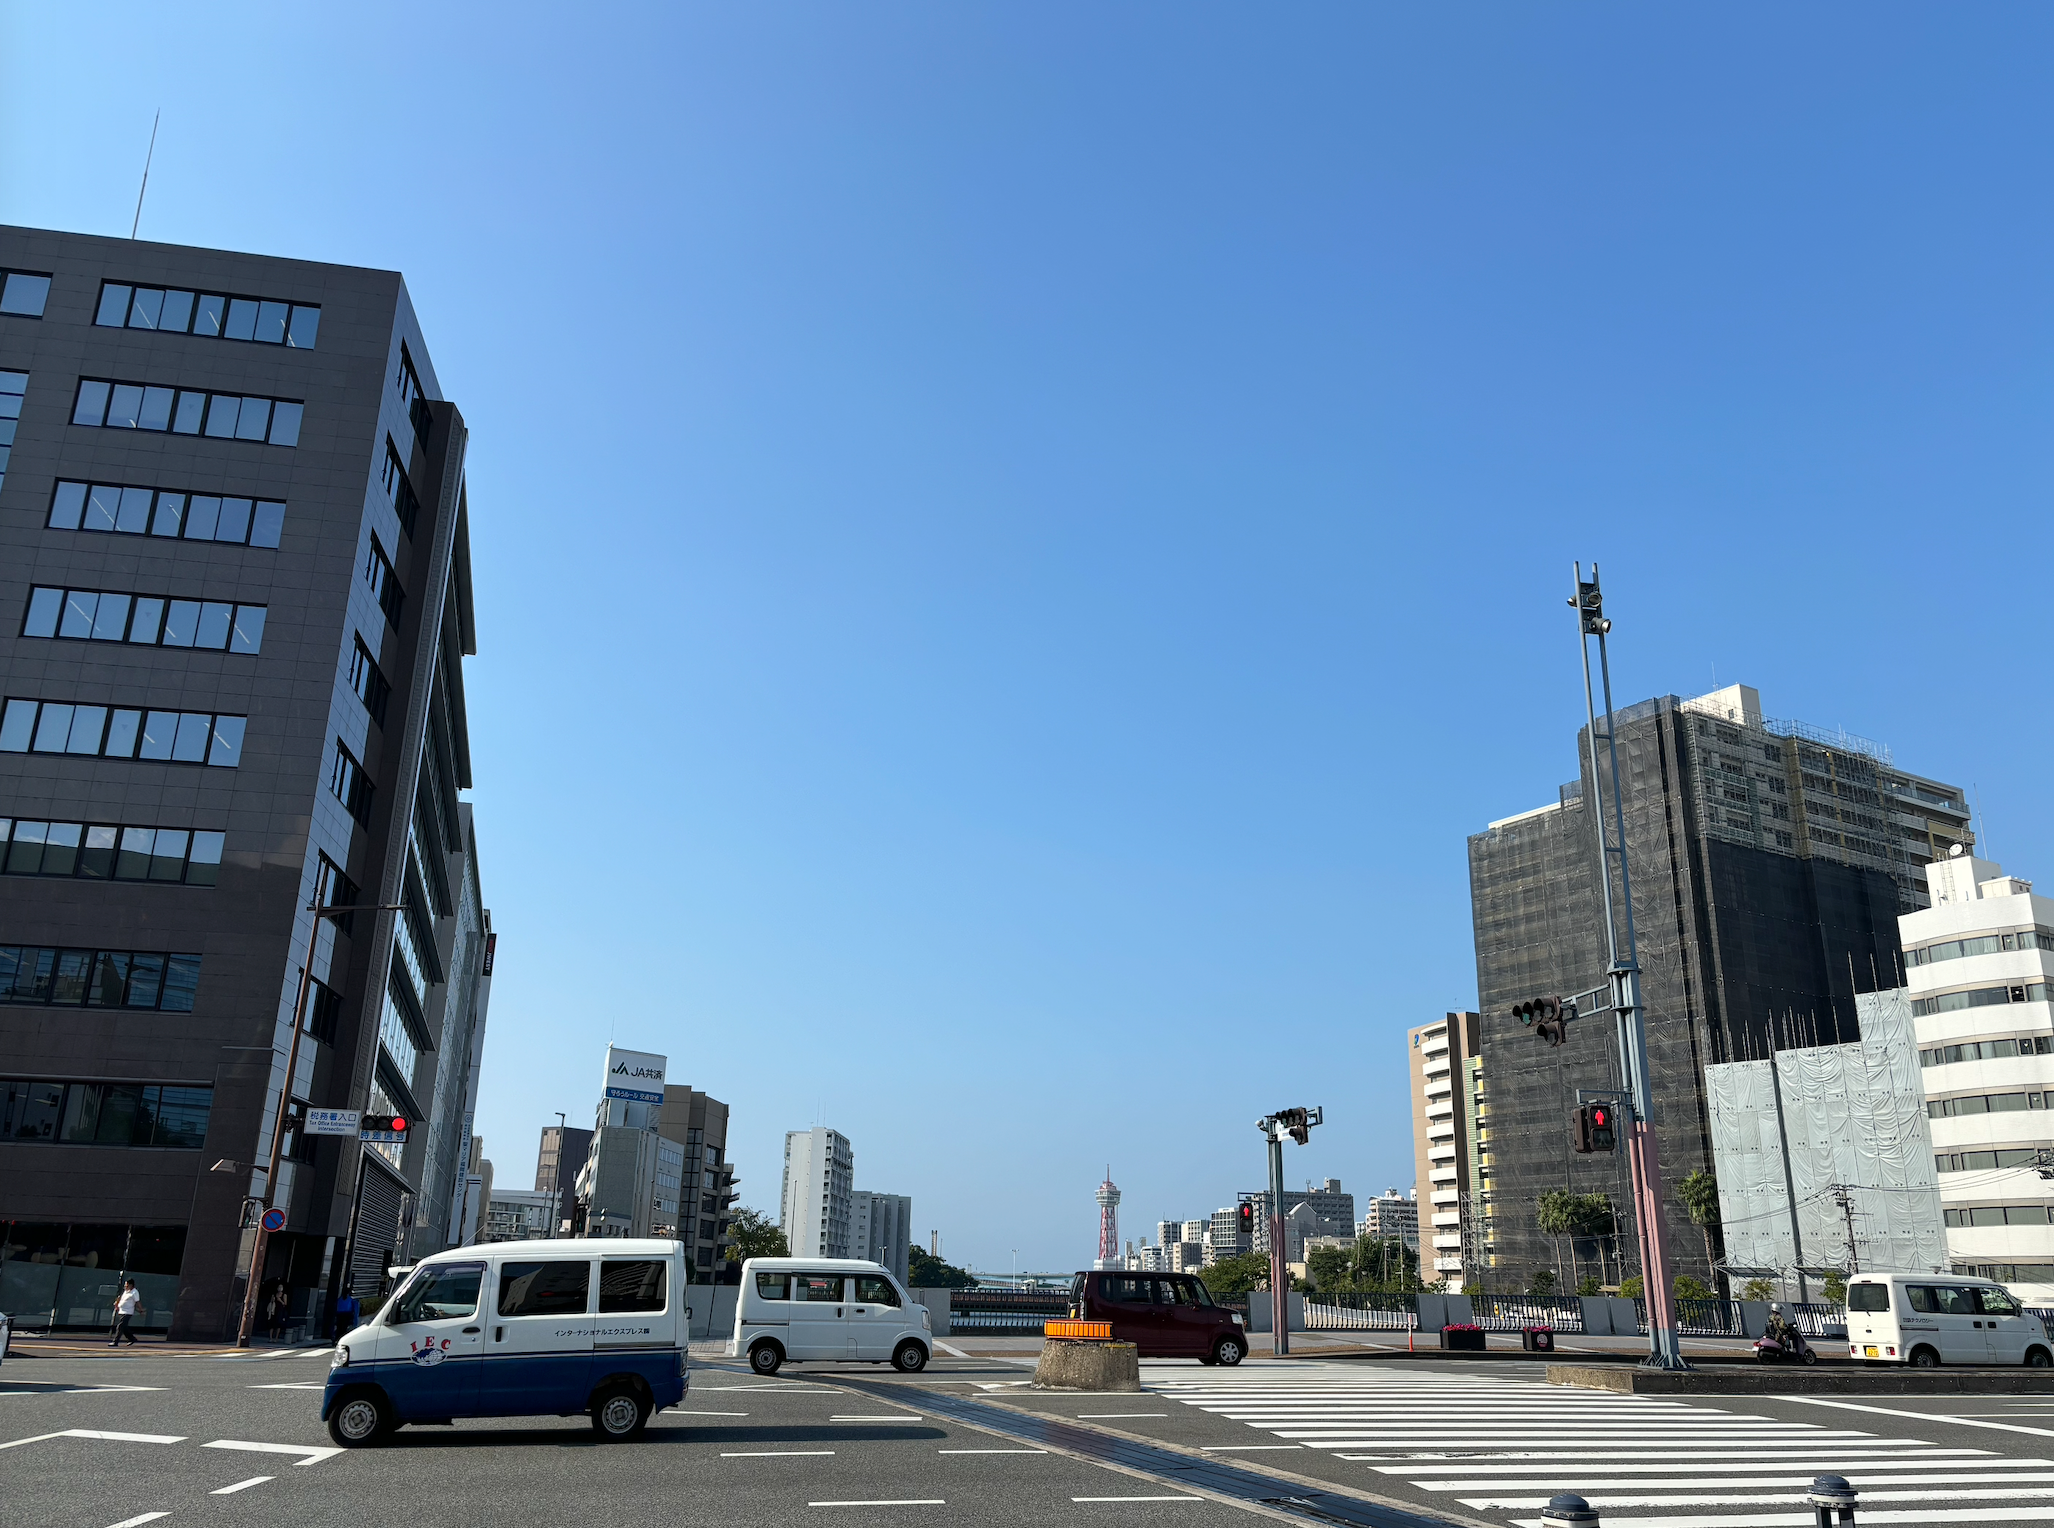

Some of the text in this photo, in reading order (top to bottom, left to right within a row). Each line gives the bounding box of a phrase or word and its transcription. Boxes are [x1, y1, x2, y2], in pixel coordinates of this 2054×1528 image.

[631, 1067, 663, 1080] JA共済
[310, 1111, 357, 1122] 税務署入口
[361, 1131, 405, 1140] 時差信号
